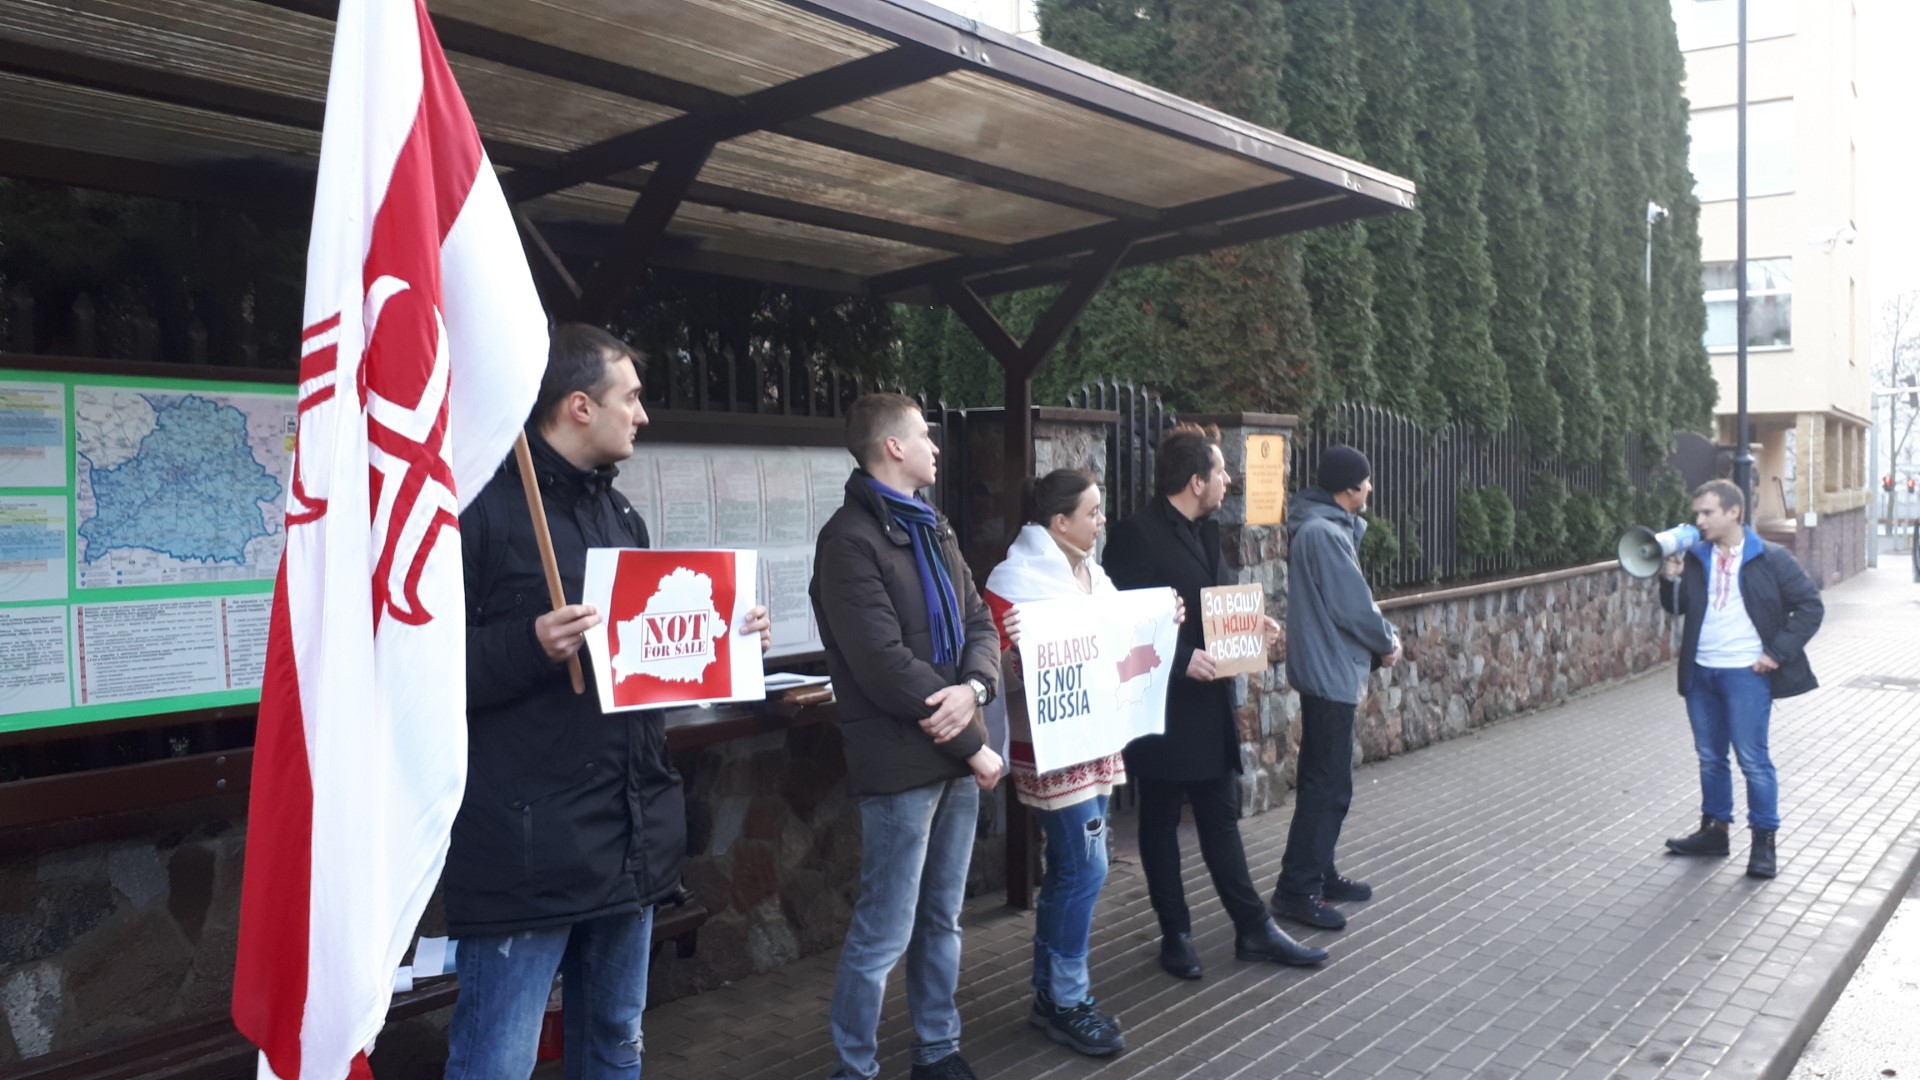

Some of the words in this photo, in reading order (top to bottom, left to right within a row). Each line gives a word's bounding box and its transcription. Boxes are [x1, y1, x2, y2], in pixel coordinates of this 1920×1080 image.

[645, 613, 707, 645] NOT
[644, 645, 670, 658] FOR
[675, 641, 705, 656] SALE
[1037, 635, 1099, 669] BELARUS
[1037, 669, 1051, 697] IS
[1055, 663, 1083, 693] NOT
[1037, 689, 1091, 725] RUSSIA
